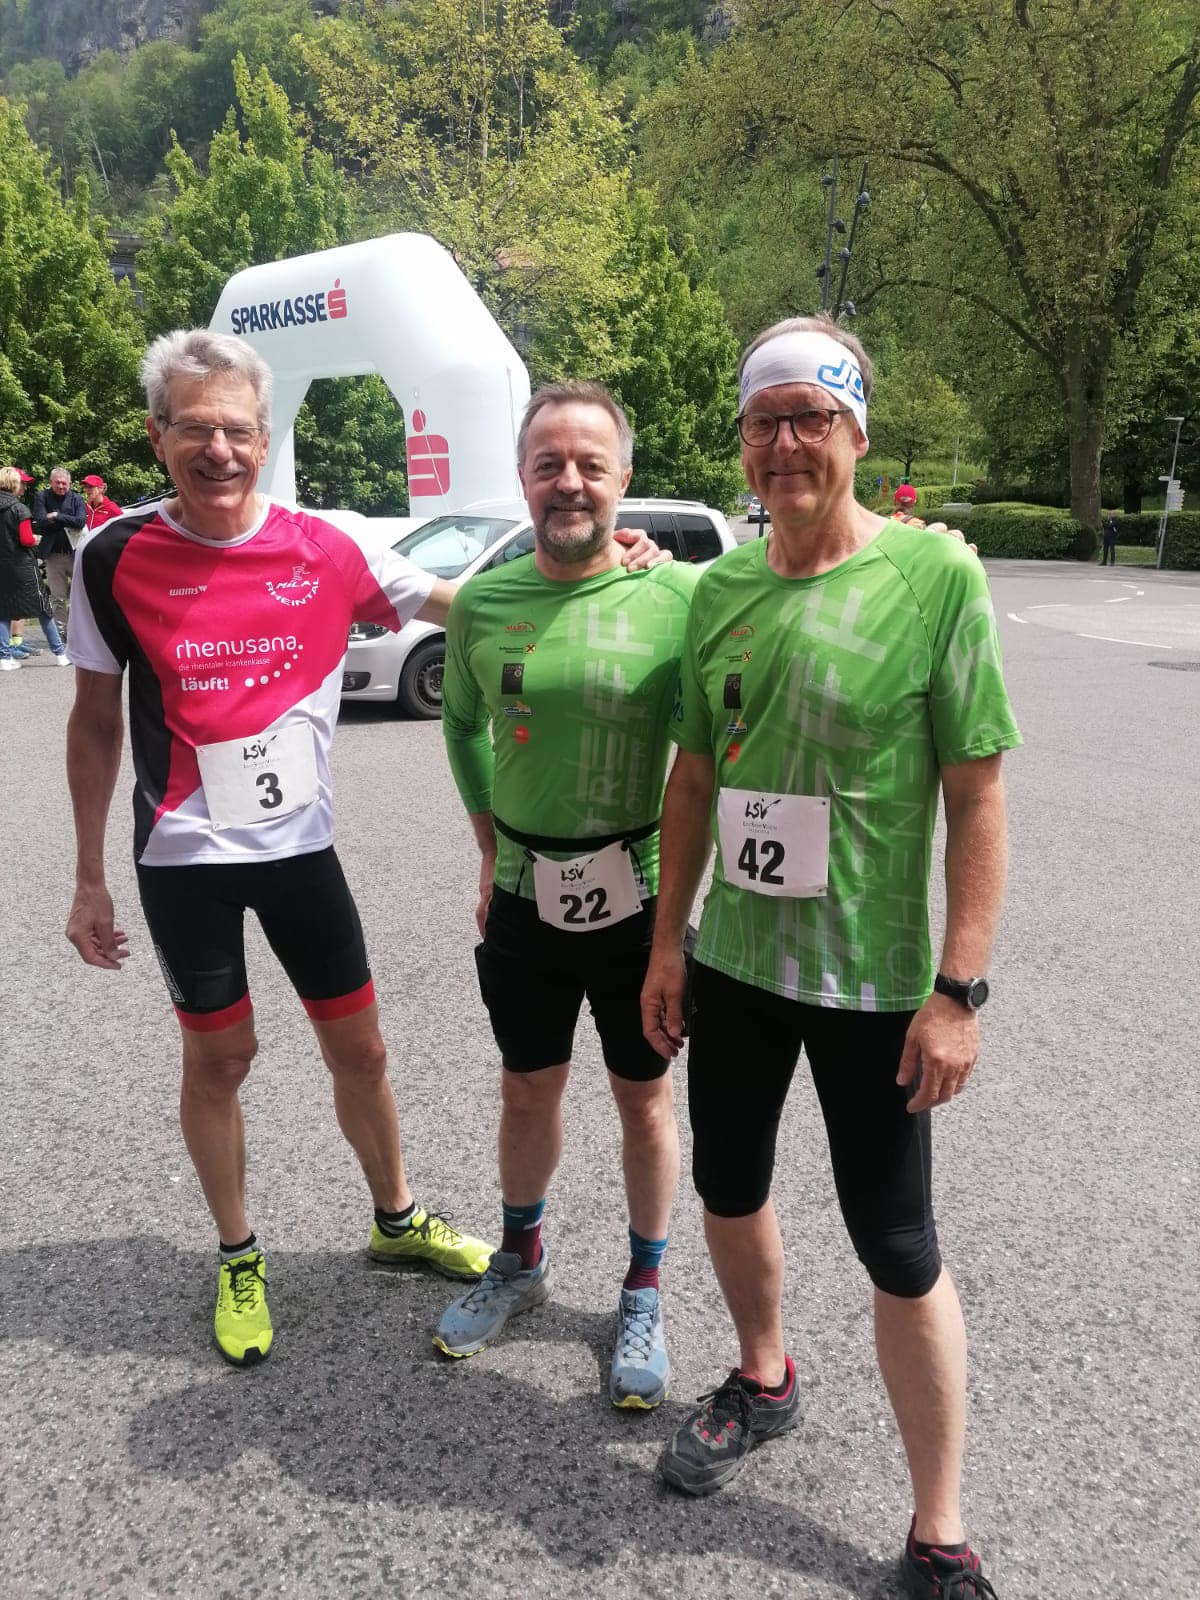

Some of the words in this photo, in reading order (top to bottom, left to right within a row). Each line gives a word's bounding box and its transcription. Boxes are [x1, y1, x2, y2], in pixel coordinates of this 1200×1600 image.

[231, 292, 328, 335] SPARKASSE
[265, 577, 320, 606] RHEINTAL
[181, 677, 229, 691] läuft!
[256, 772, 283, 809] 3
[738, 838, 785, 886] 42
[560, 888, 611, 924] 22
